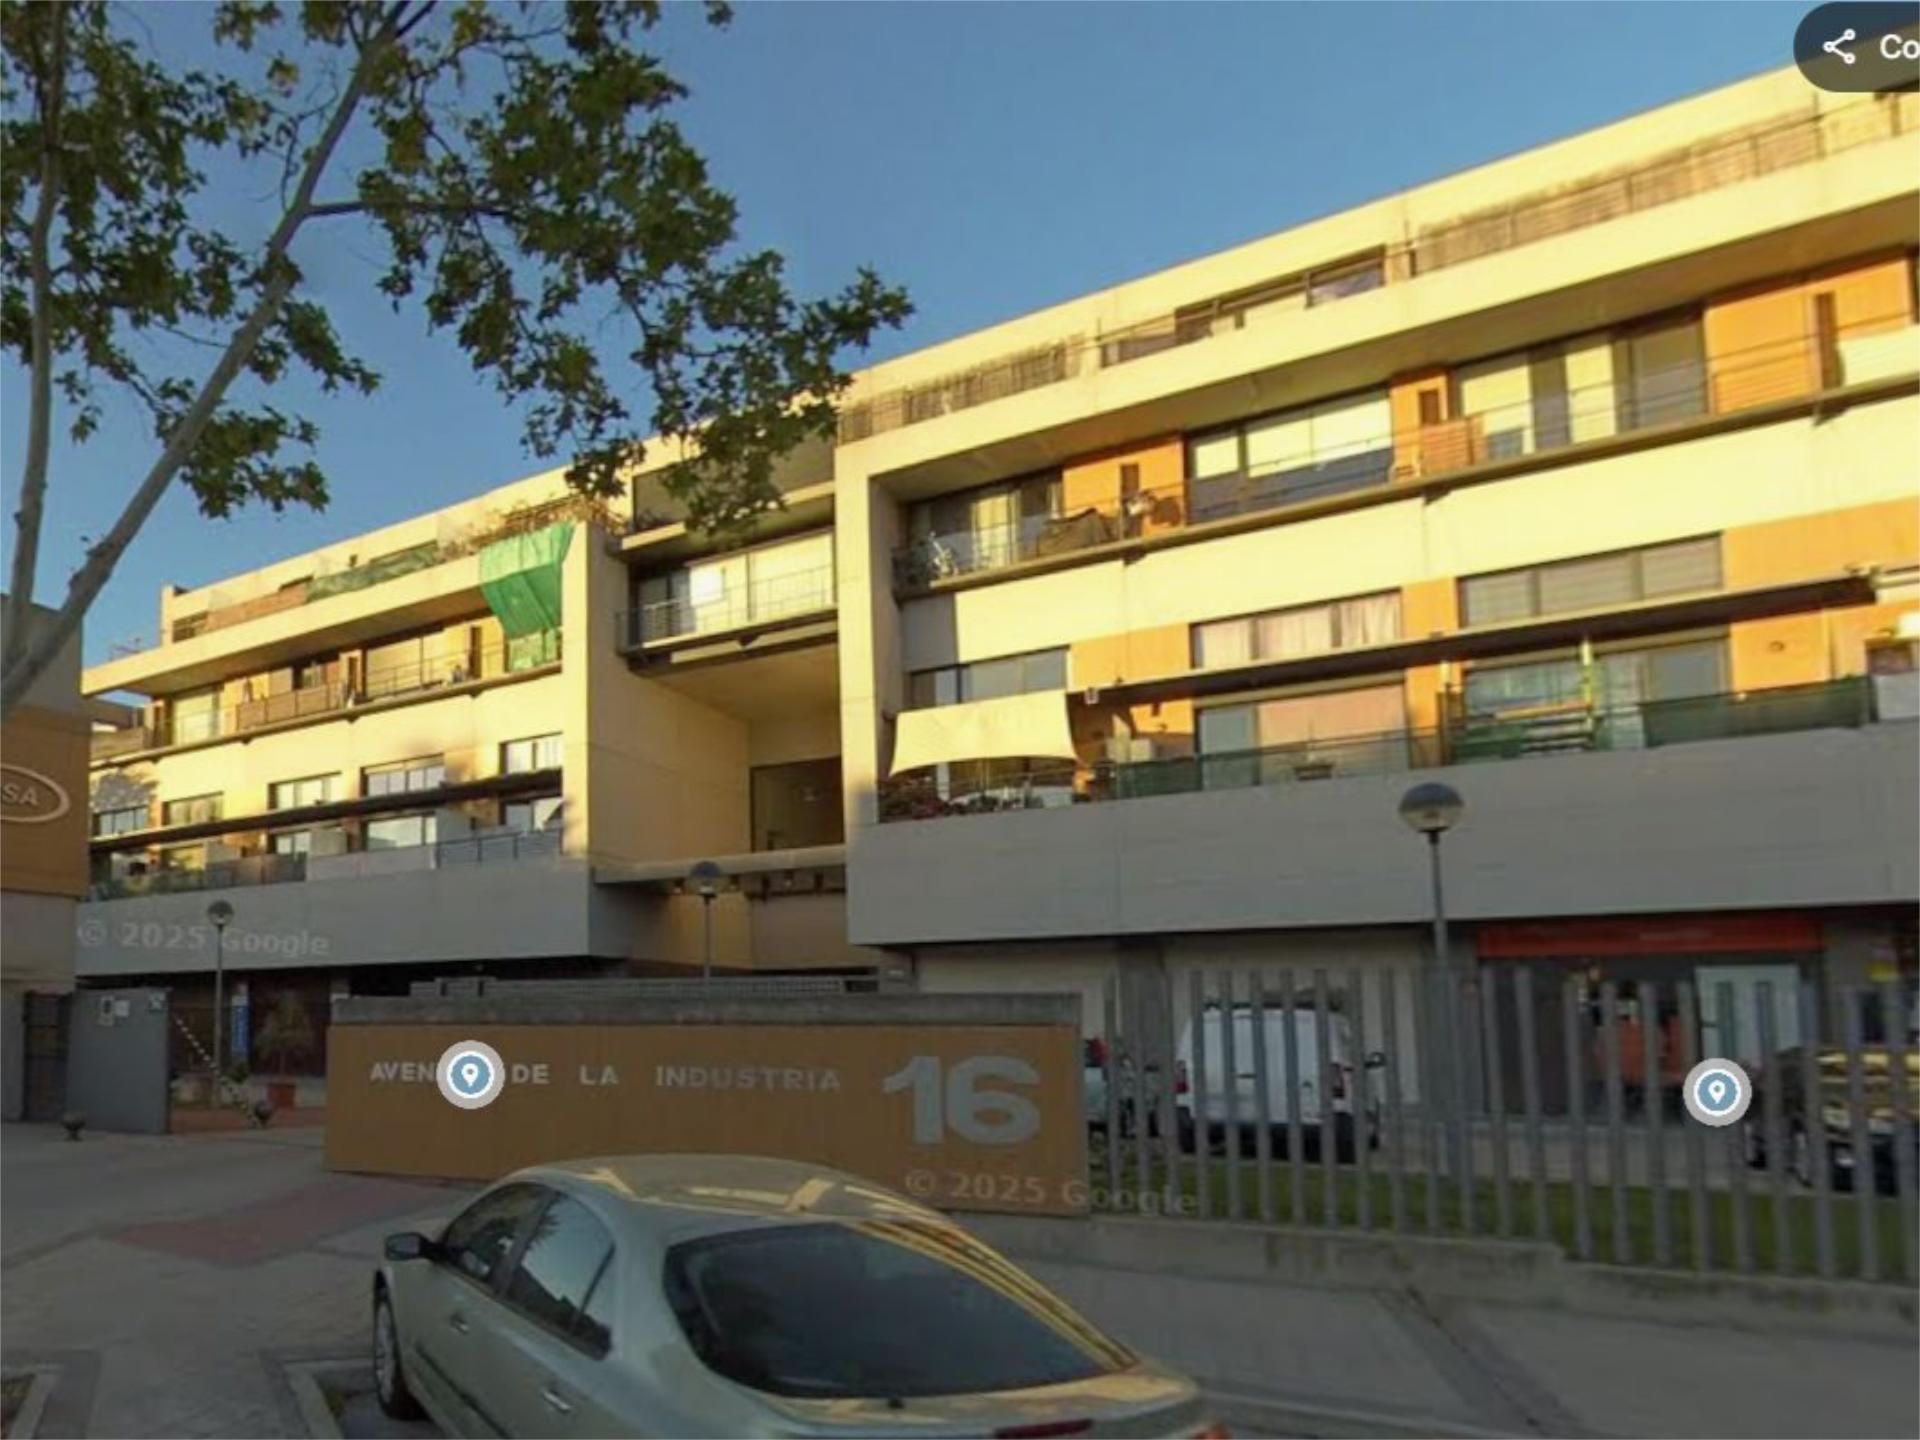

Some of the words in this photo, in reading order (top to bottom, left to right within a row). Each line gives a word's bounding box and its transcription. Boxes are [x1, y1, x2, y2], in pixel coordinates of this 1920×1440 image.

[511, 1064, 550, 1085] DE
[579, 1064, 619, 1087] LA
[656, 1065, 841, 1092] INDUSTRIA
[882, 1055, 1041, 1146] 16
